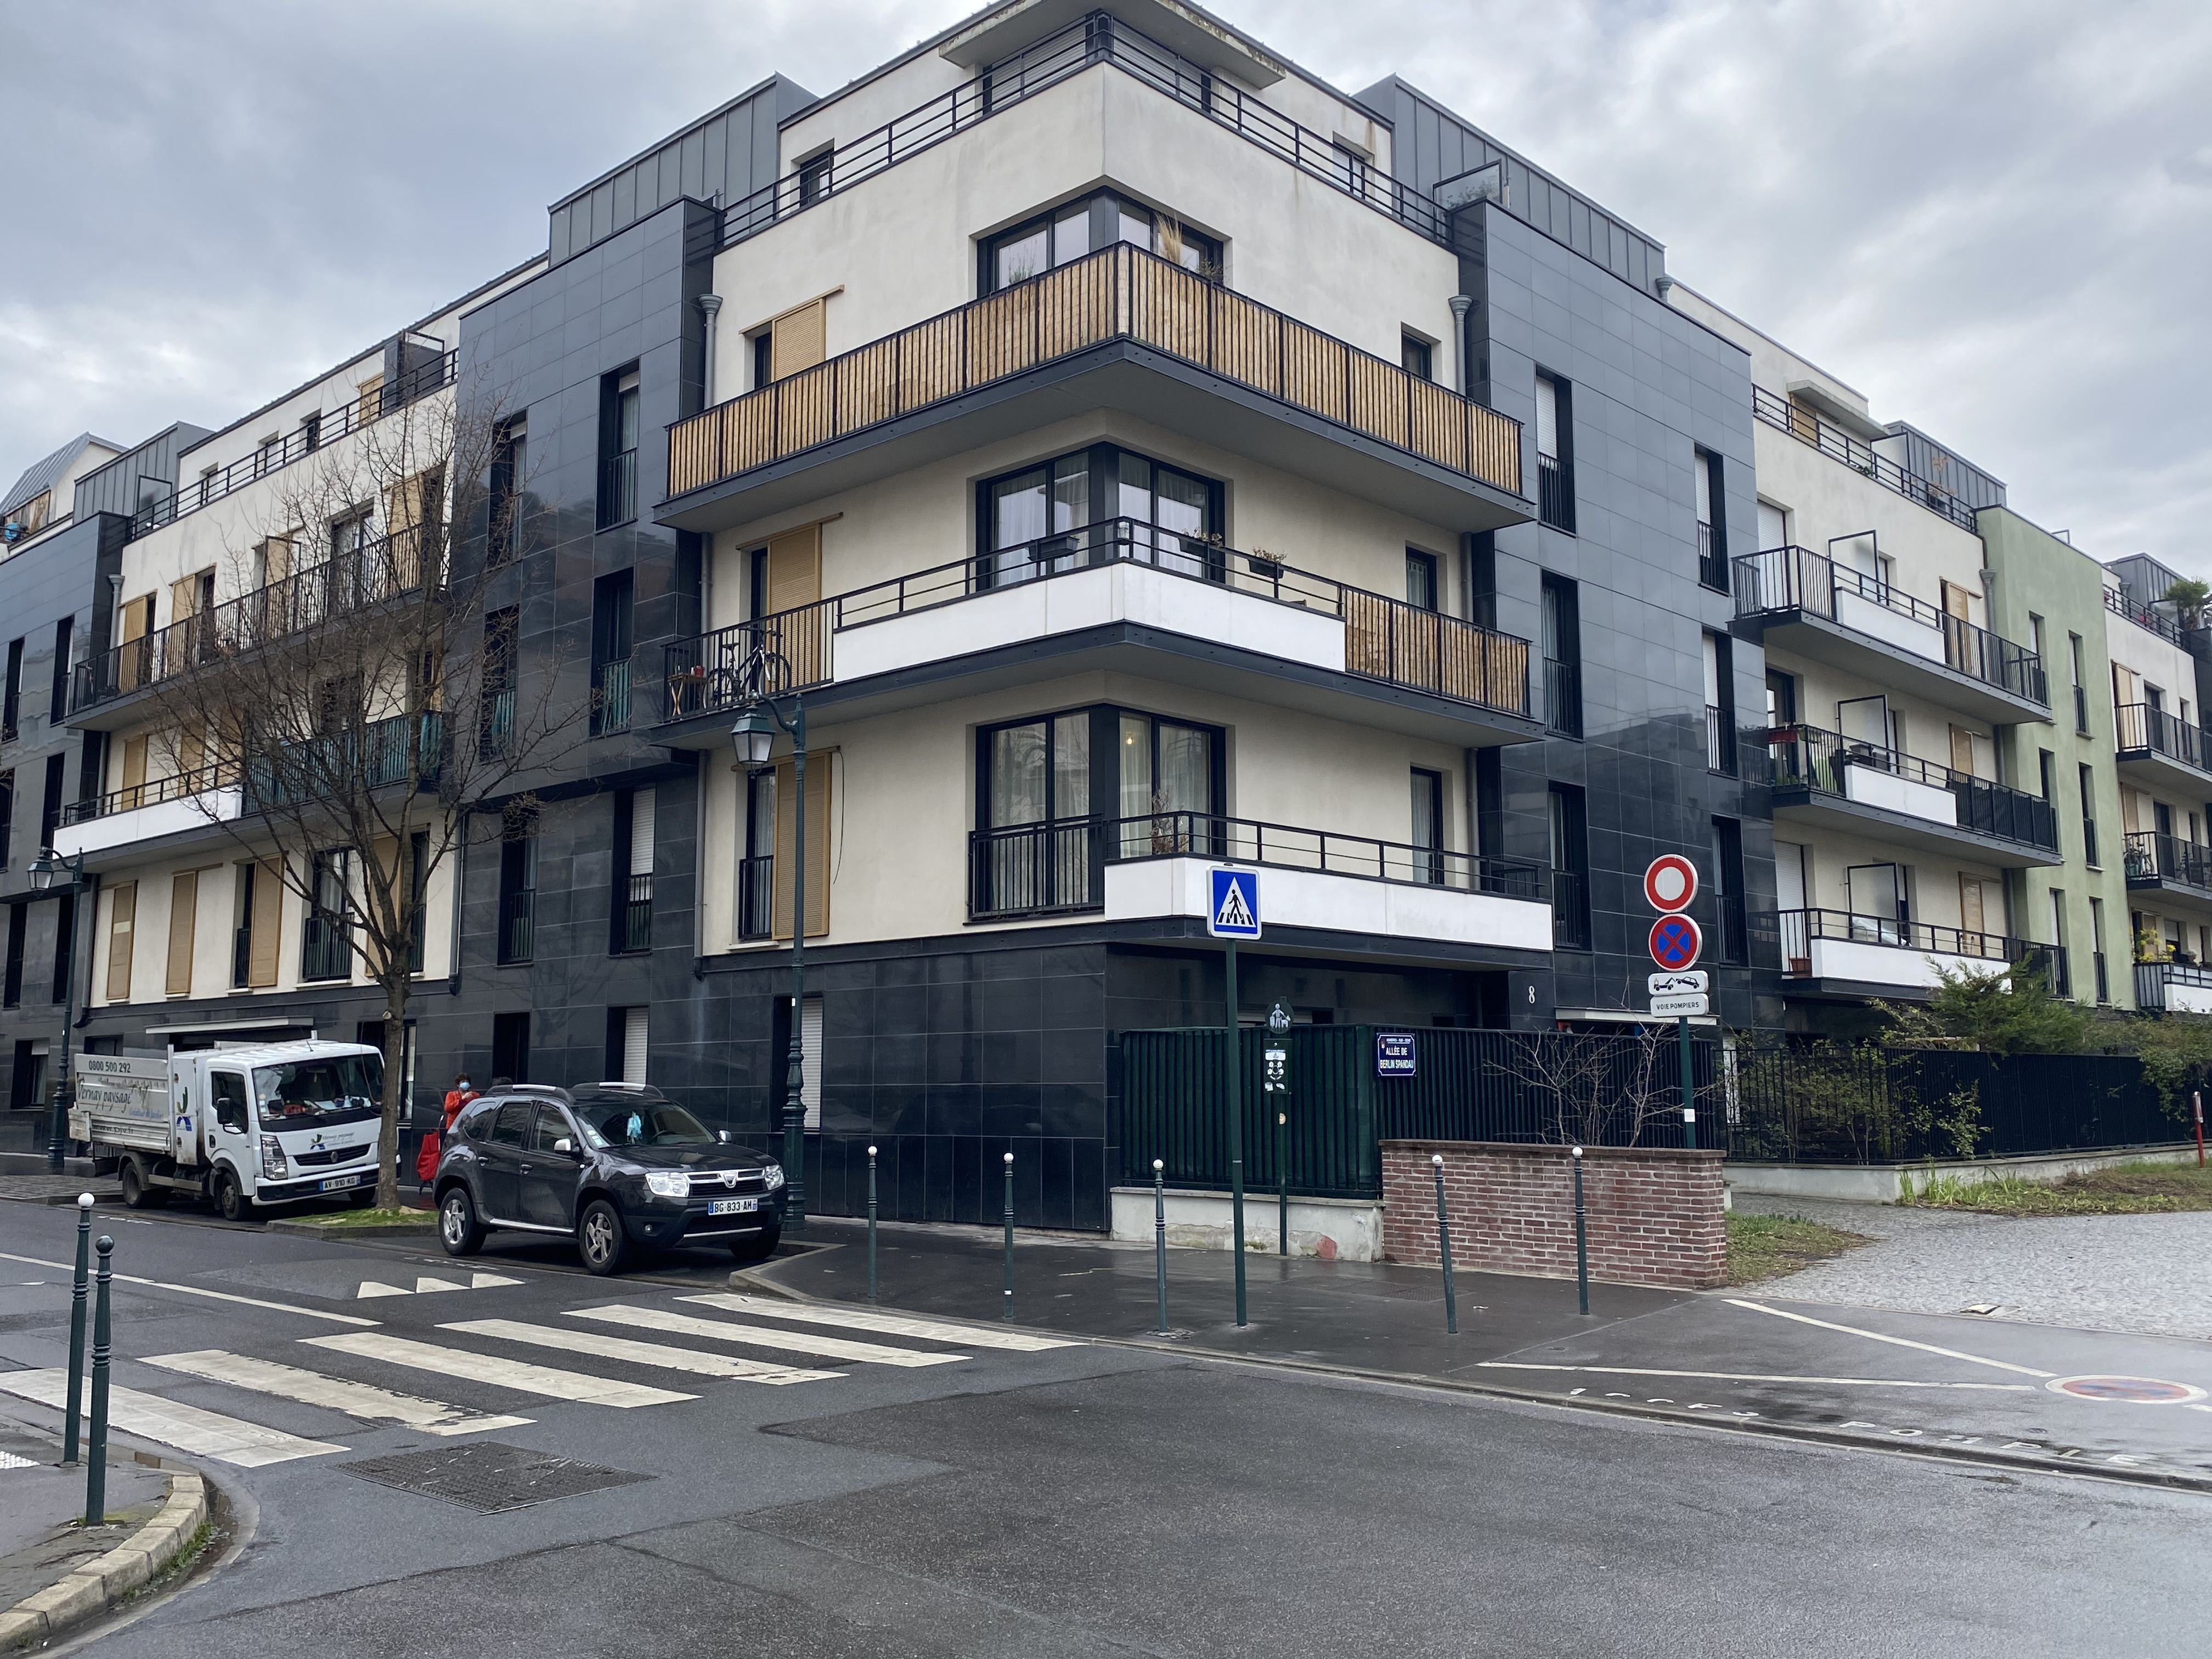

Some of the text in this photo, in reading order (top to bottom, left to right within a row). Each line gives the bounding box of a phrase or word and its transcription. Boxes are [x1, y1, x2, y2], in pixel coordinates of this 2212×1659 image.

[1528, 985, 1535, 1004] 8
[1386, 1045, 1408, 1056] ALLÉE DE
[88, 1060, 131, 1073] 0800 500 292
[1380, 1059, 1414, 1069] BERLIN SPANDAU
[77, 1080, 132, 1113] Vernay paysage
